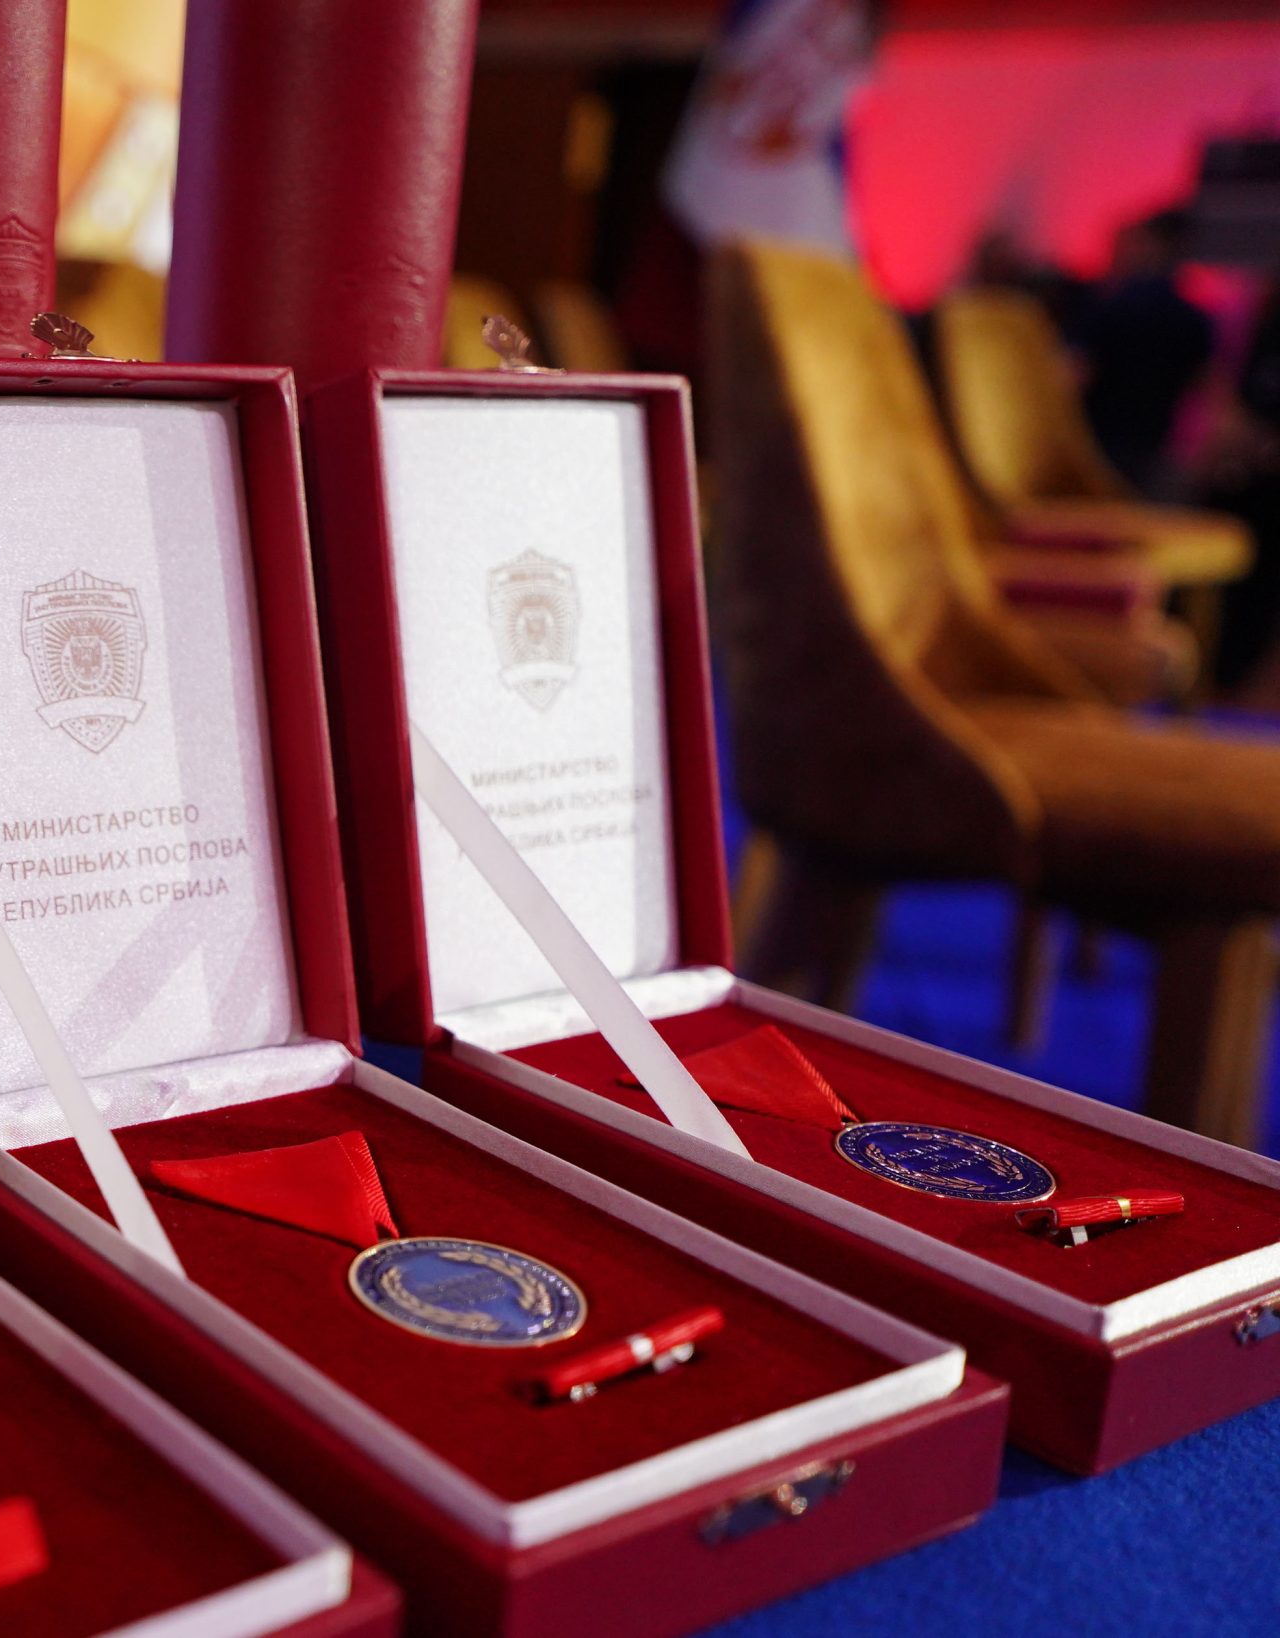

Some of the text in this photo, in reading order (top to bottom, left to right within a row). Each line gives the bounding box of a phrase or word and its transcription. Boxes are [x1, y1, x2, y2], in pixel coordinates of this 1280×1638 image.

[2, 804, 200, 842] МИНИСТАРСТВО
[138, 837, 248, 866] ПОСЛОВА
[139, 877, 231, 904] СРБИЈА
